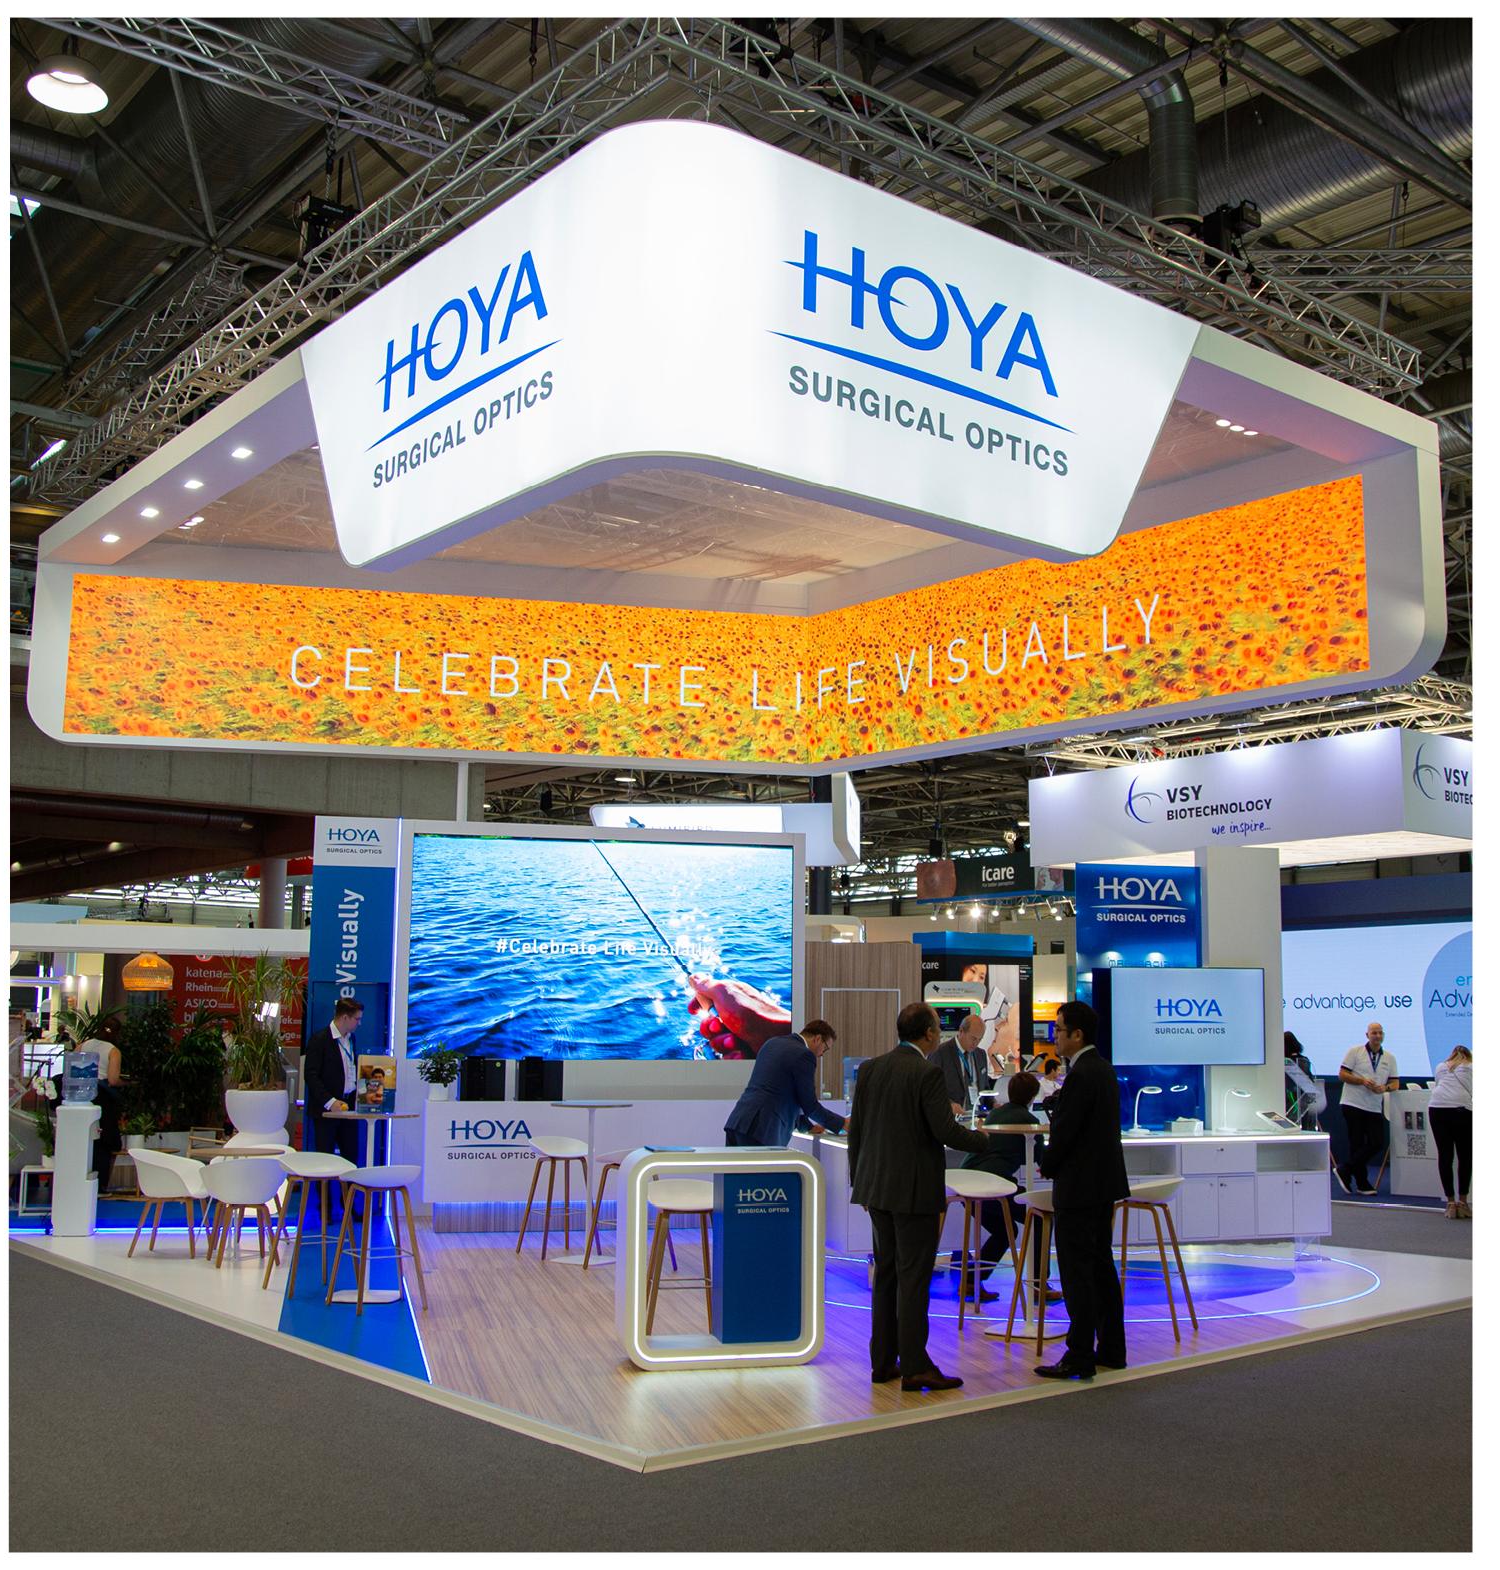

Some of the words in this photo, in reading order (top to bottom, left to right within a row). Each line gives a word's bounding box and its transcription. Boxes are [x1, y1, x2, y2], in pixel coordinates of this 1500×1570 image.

[782, 229, 1059, 398] HOYA
[376, 250, 548, 412] HOYA
[373, 420, 466, 488] SURGICAL
[473, 370, 553, 435] OPTICS
[789, 365, 954, 442] SURGICAL
[965, 422, 1069, 477] OPTICS
[290, 645, 706, 708] CELEBRATE
[752, 661, 866, 712] LIFE
[894, 593, 1160, 694] VISUALLY
[1444, 767, 1469, 787] VSY
[1166, 785, 1203, 804] VSY
[1166, 798, 1273, 821] BIOTECHNOLOGY
[327, 828, 380, 842] HOYA
[1211, 824, 1226, 836] we
[1230, 820, 1272, 837] inspire...
[982, 866, 1015, 882] icare
[1094, 877, 1182, 901] HOYA
[1096, 913, 1147, 922] SURGICAL
[1150, 914, 1186, 924] OPTICS
[495, 937, 598, 955] #Celebrate
[186, 967, 223, 978] katena
[186, 982, 213, 992] Rhein
[1154, 999, 1222, 1017] HOYA
[1293, 993, 1376, 1012] advantage,
[1384, 994, 1413, 1008] use
[1429, 989, 1473, 1008] Adv
[1155, 1027, 1194, 1035] SURGICAL
[1197, 1027, 1226, 1035] OPTICS
[447, 1120, 532, 1140] HOYA
[447, 1152, 497, 1160] SURGICAL
[500, 1152, 536, 1160] OPTICS
[737, 1188, 788, 1202] HOYA
